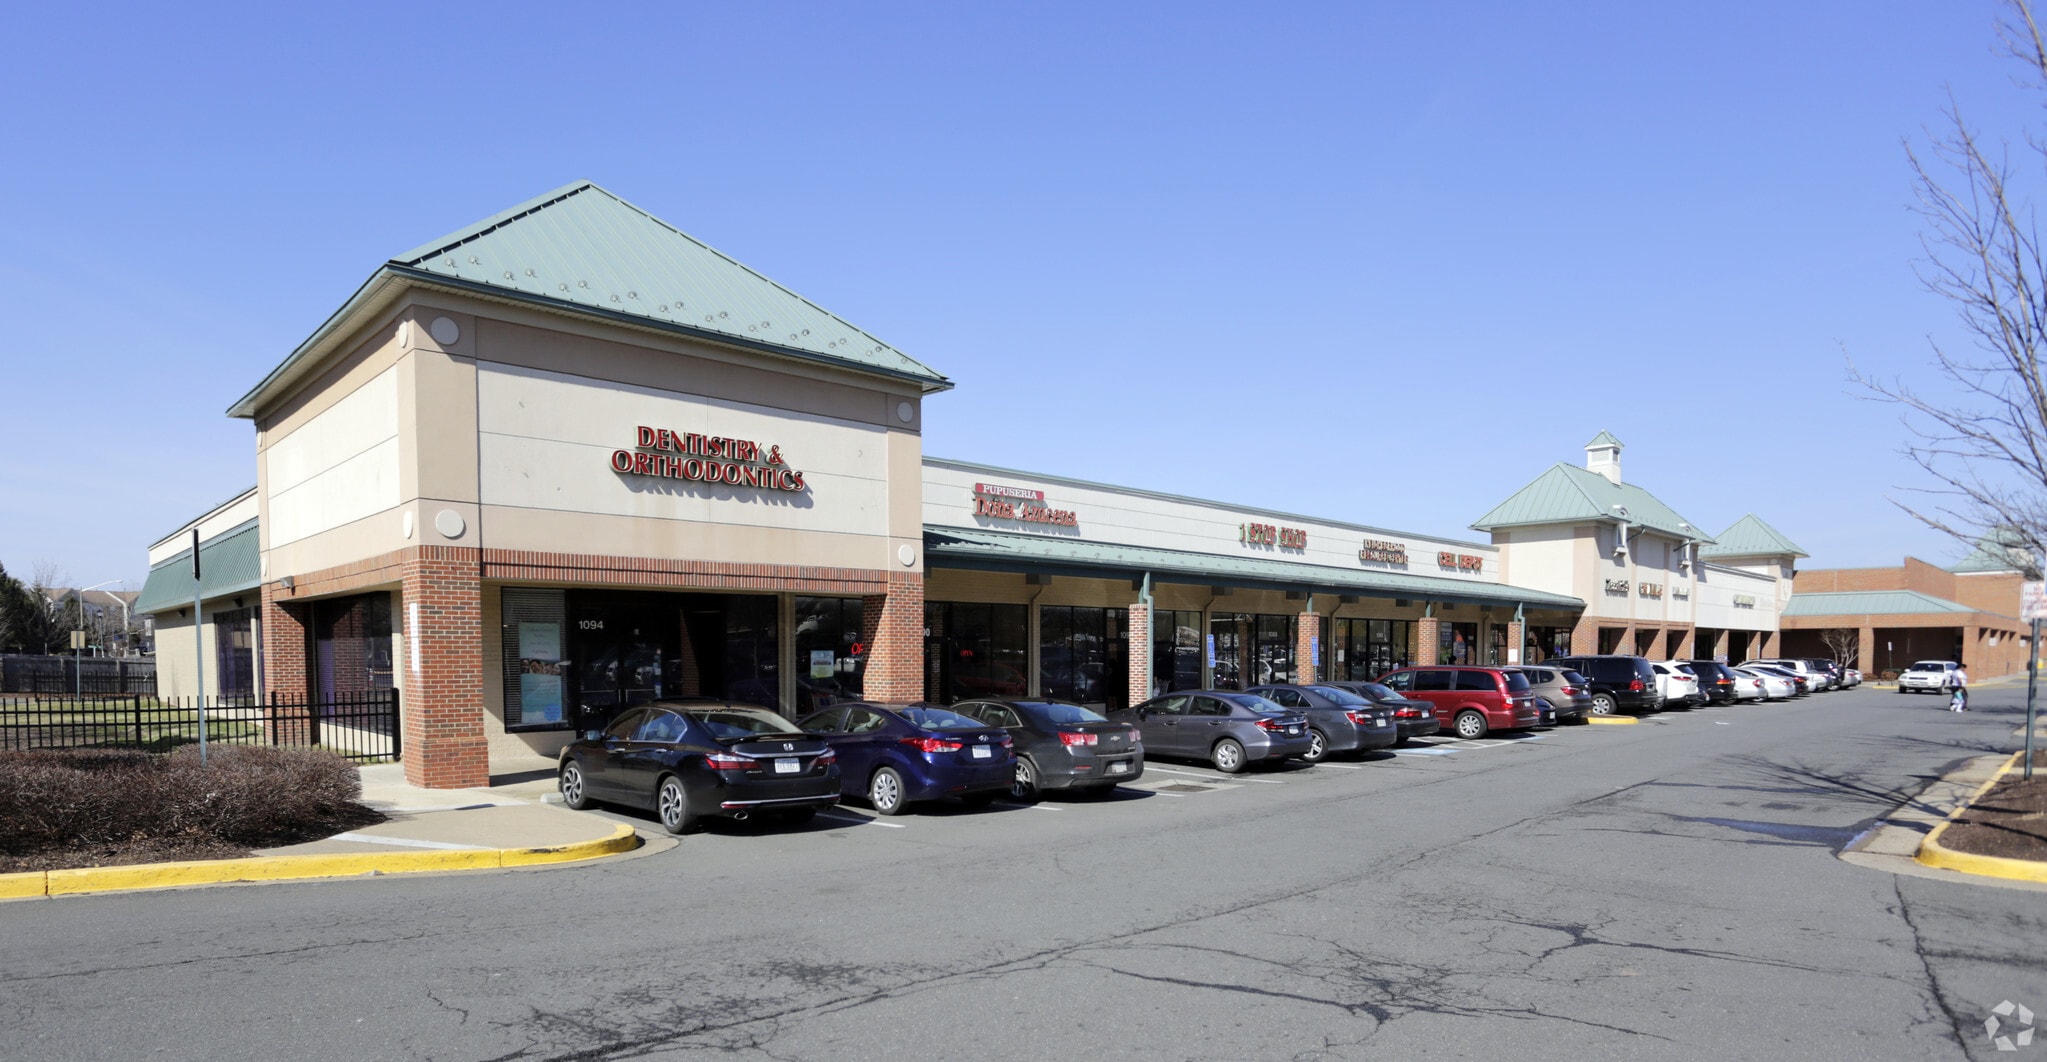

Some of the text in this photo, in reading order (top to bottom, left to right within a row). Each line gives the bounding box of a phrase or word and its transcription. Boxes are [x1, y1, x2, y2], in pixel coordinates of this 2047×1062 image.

[636, 425, 784, 466] DENTISTRY &
[611, 450, 805, 491] ORTHODONTICS
[983, 485, 1037, 499] PUPUSERIA
[1016, 502, 1078, 526] Azucena
[1239, 522, 1307, 550] 1 STOP SHOP
[1437, 551, 1483, 570] CELL DEPOT
[578, 620, 604, 630] 1094
